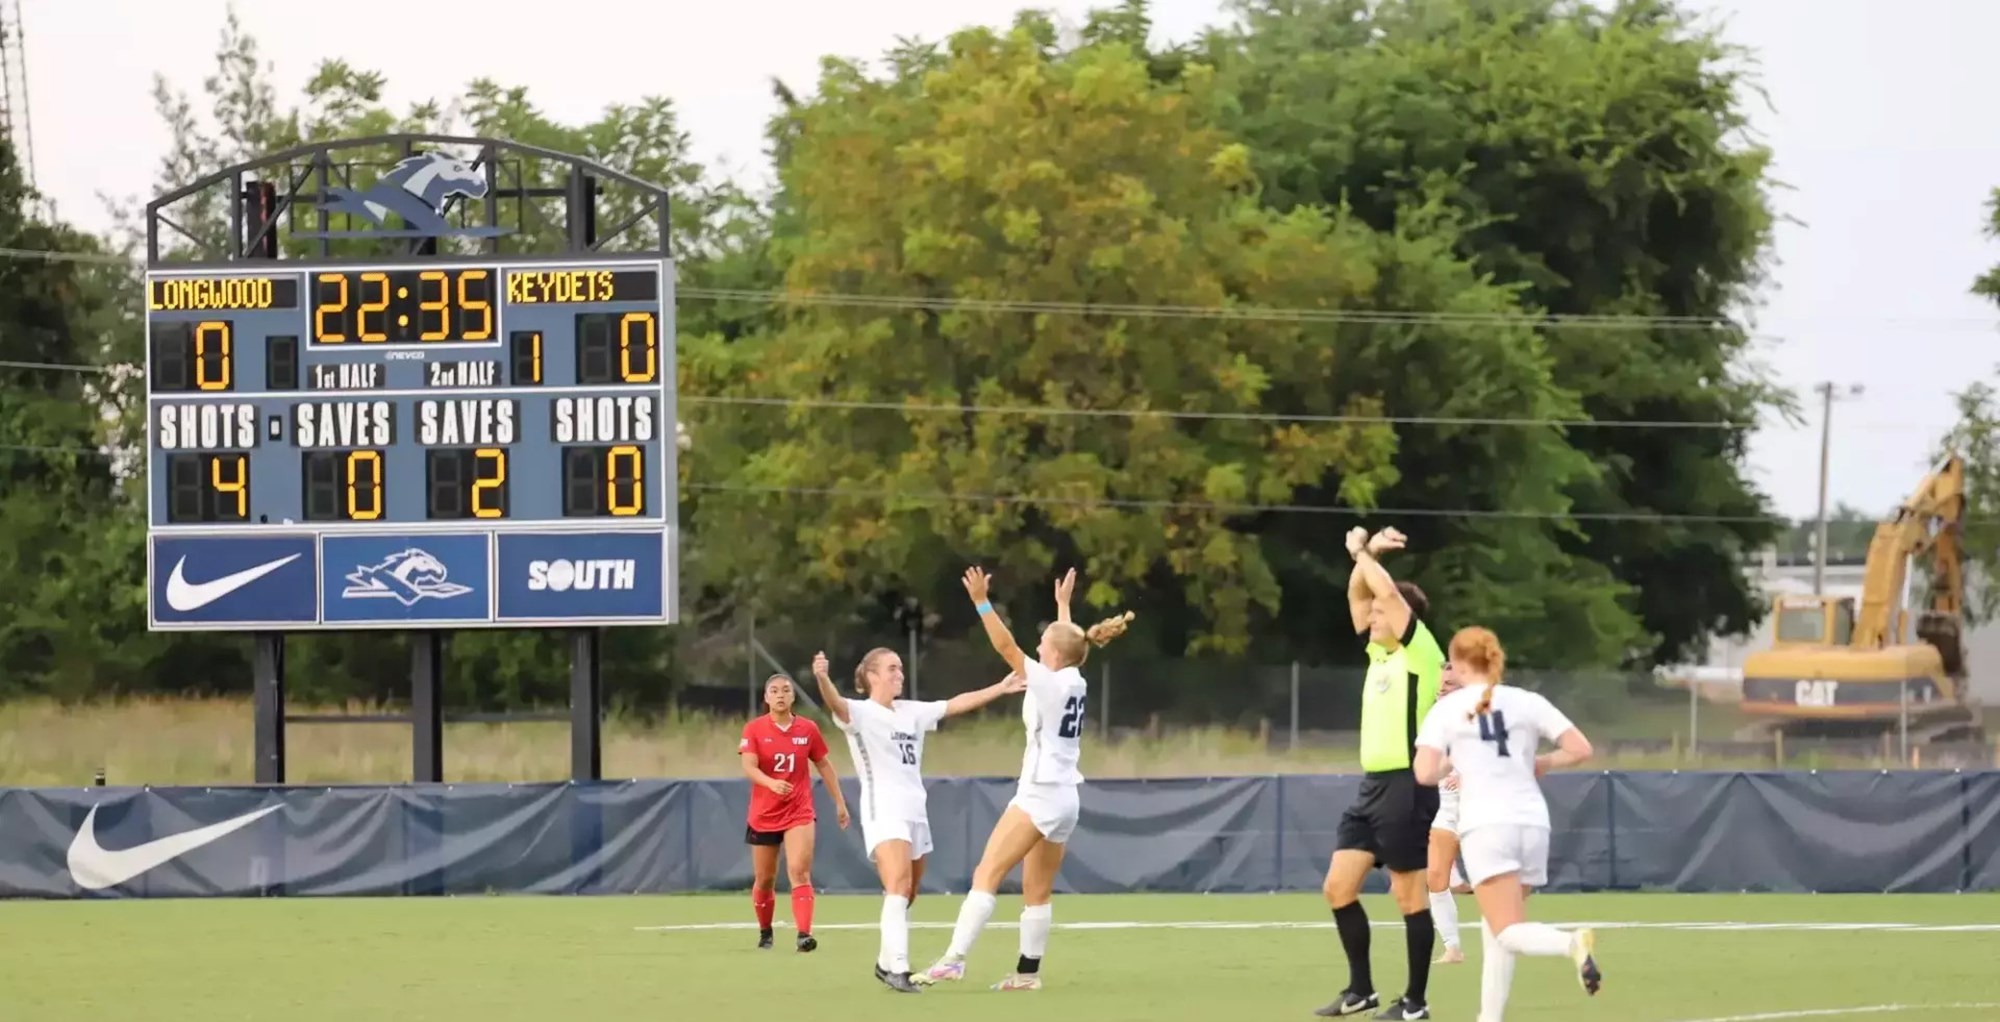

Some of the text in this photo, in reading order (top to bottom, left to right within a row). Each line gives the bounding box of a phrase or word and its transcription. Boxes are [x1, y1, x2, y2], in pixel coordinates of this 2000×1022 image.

[149, 279, 273, 309] LONGWOOD
[315, 271, 492, 343] 22:35
[507, 270, 614, 303] KEYDETS
[195, 321, 230, 391] 0
[531, 333, 541, 383] 1
[620, 312, 655, 383] 0
[315, 365, 377, 389] 1st HALF
[430, 362, 495, 387] 2nd HALF
[160, 404, 255, 449] SHOTS
[297, 401, 391, 447] SAVES
[421, 399, 514, 445] SAVES
[556, 396, 653, 442] SHOTS
[211, 456, 246, 518] 4
[346, 449, 381, 520] 0
[471, 448, 505, 518] 2
[606, 445, 642, 517] 0
[528, 558, 635, 591] SOUTH
[1796, 680, 1838, 706] CAT
[899, 743, 916, 765] 16
[1478, 710, 1510, 757] 4
[773, 752, 796, 773] 21
